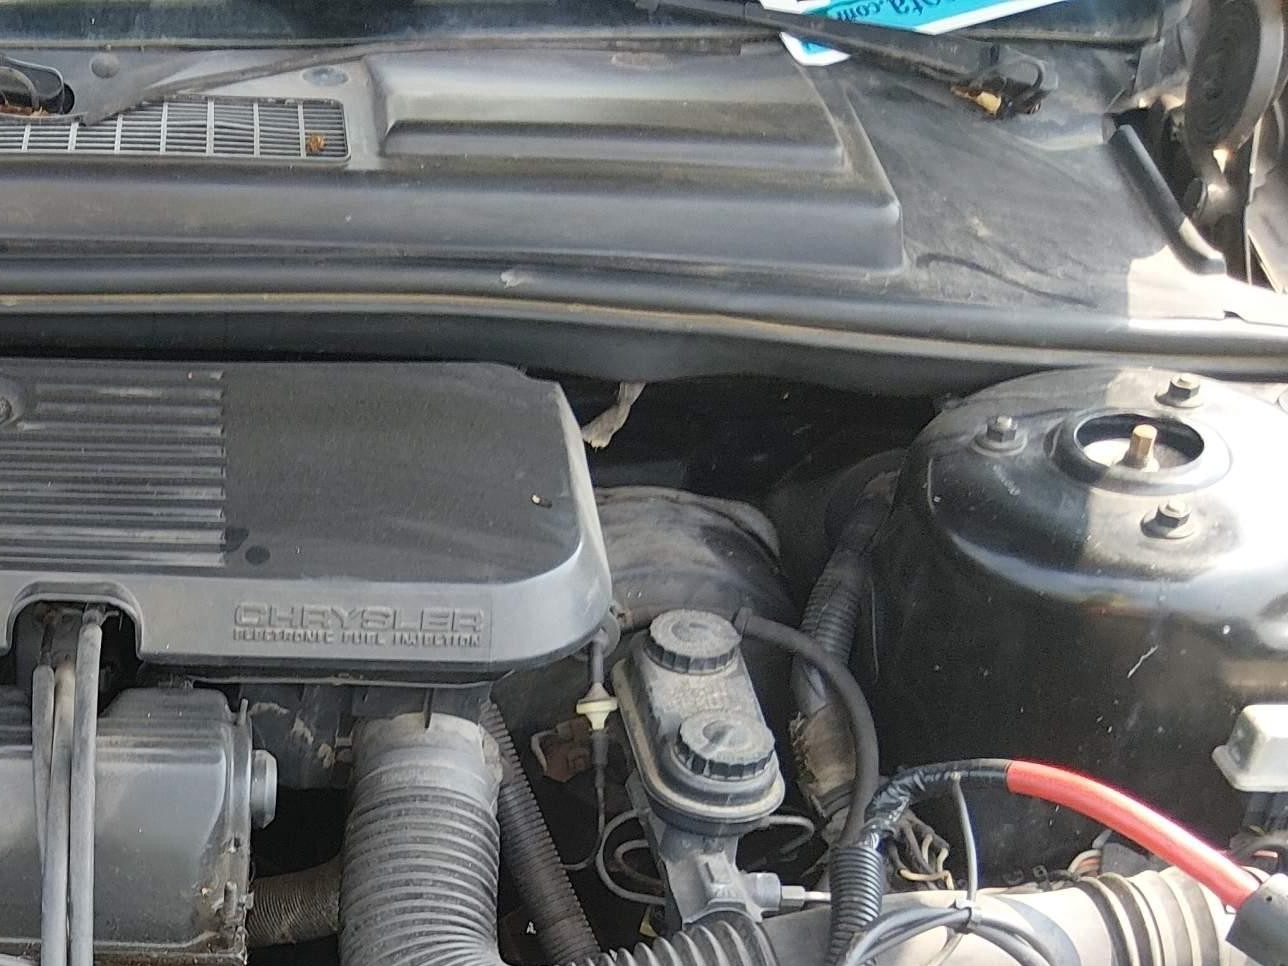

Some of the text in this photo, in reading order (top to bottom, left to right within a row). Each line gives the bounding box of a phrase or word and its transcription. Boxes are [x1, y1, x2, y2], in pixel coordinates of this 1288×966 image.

[233, 602, 484, 632] CHRYSLER
[233, 627, 481, 648] ELECTRONIC FUEL INJECTION
